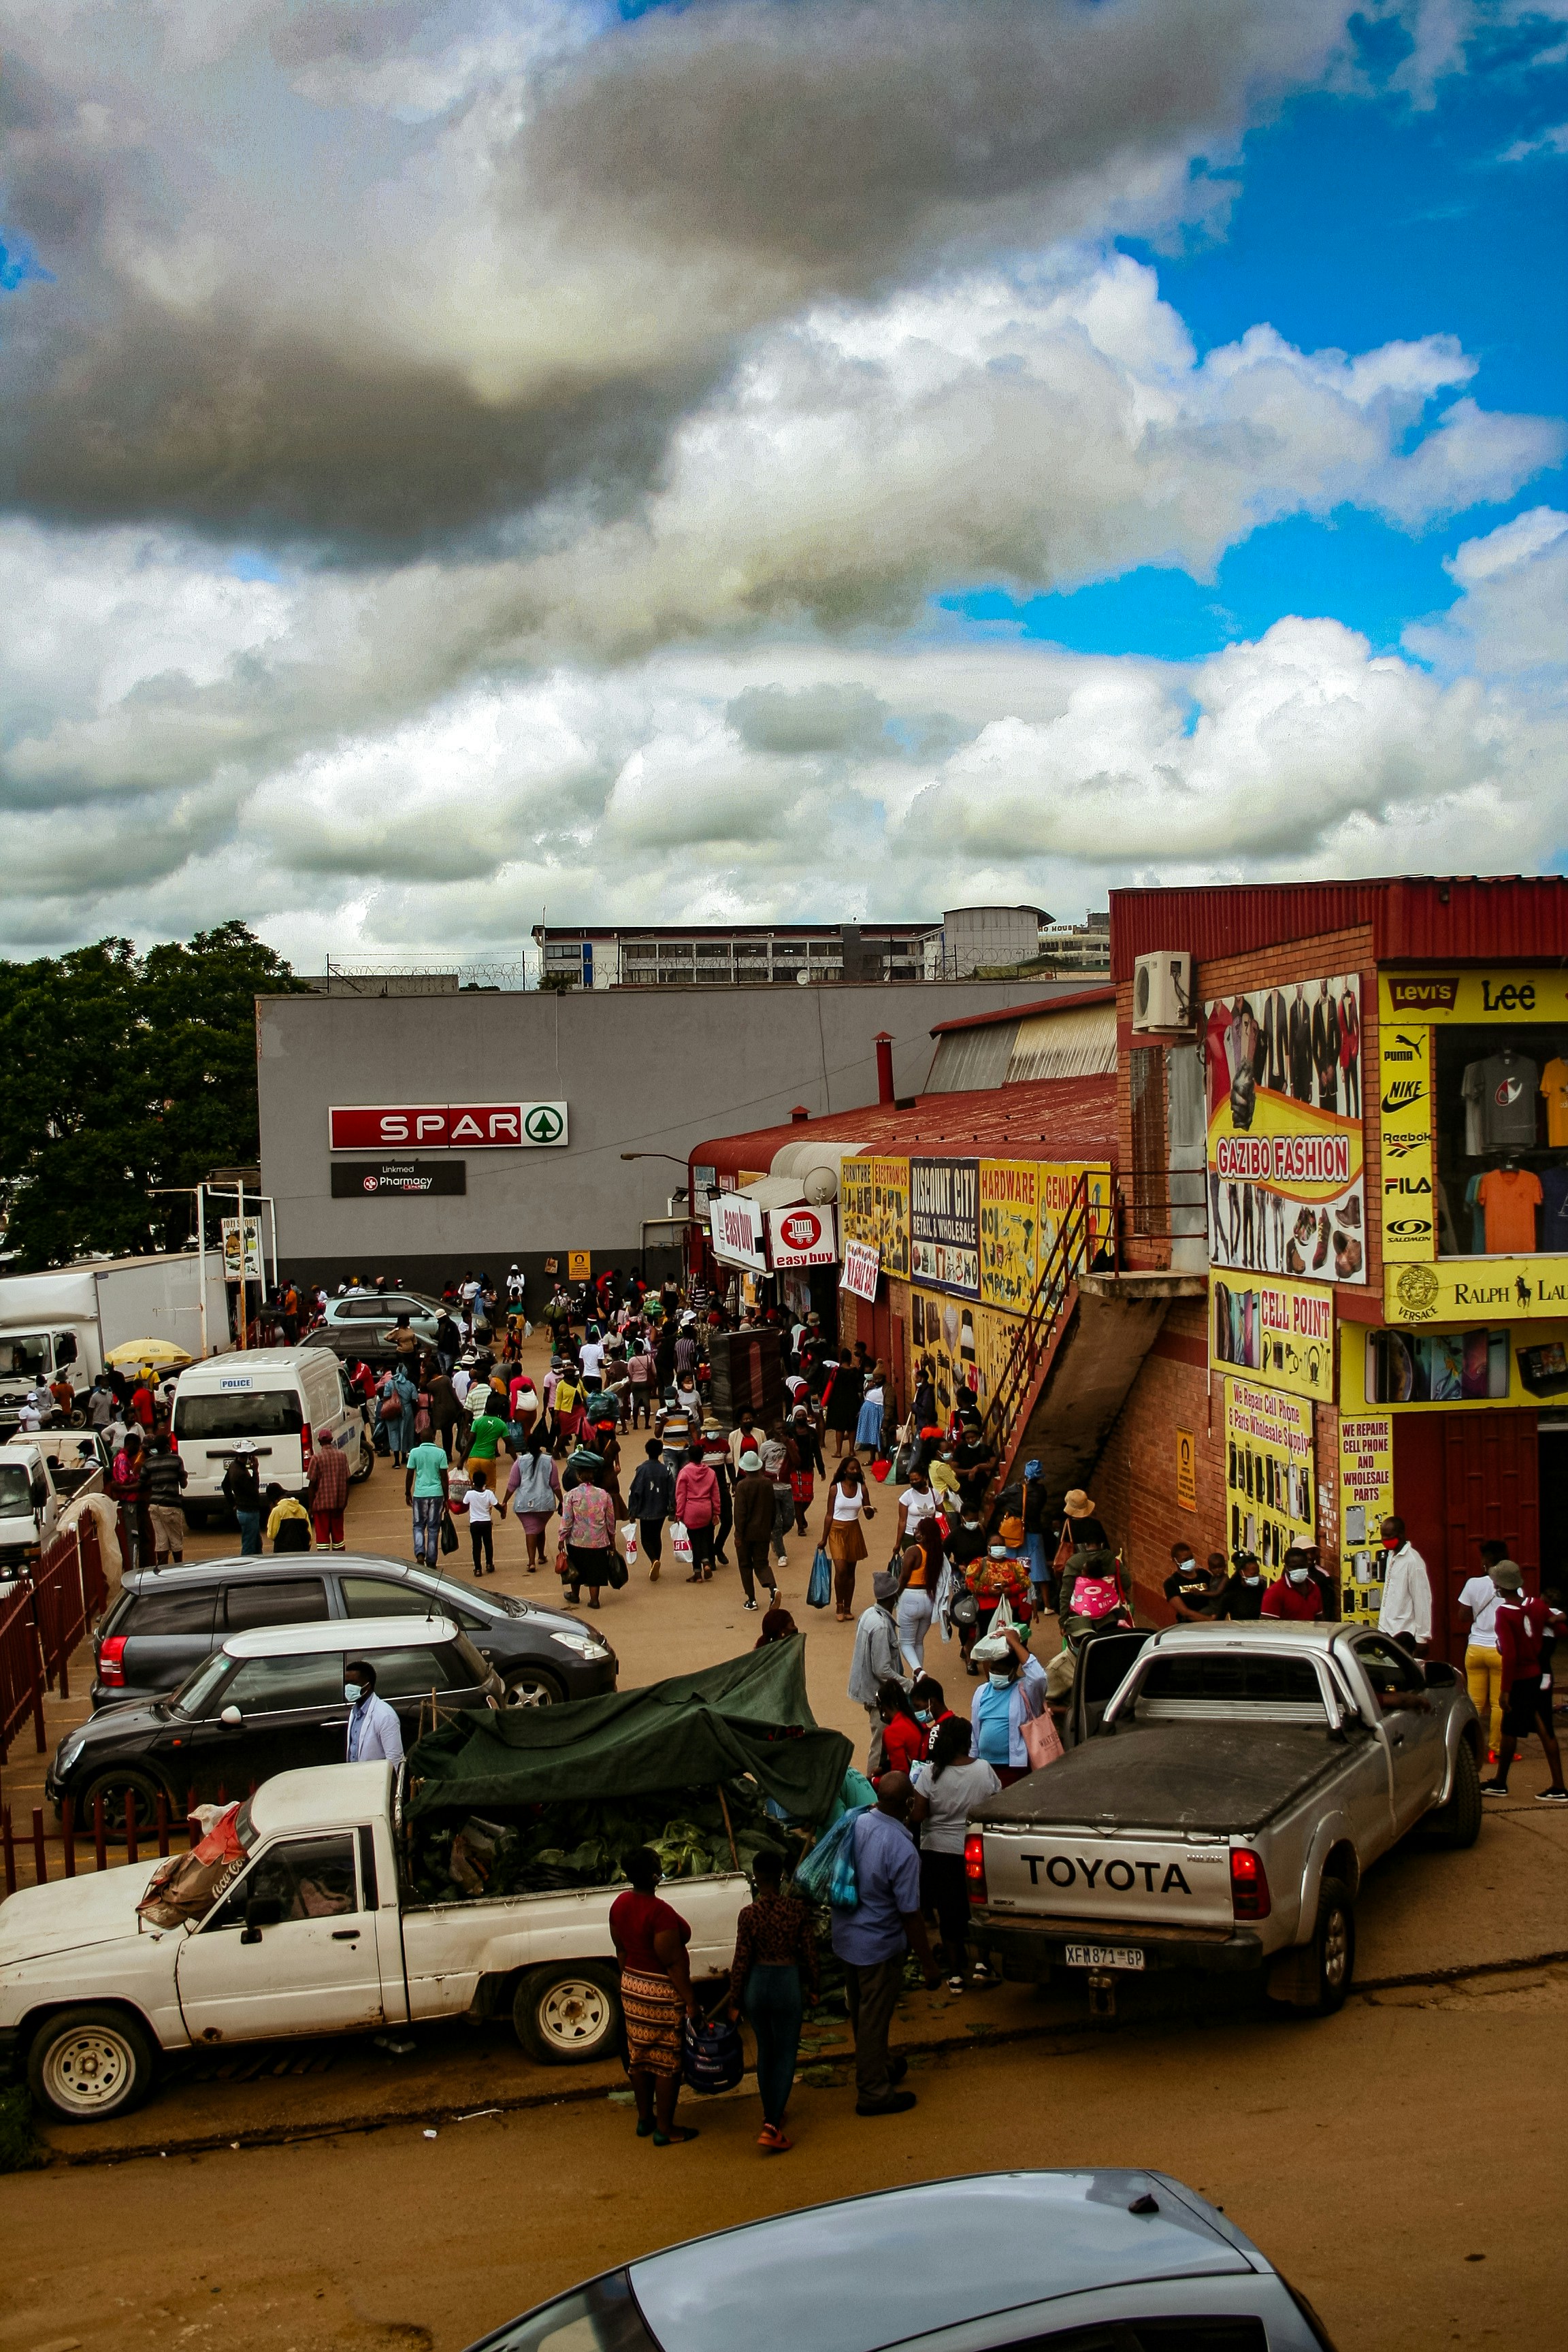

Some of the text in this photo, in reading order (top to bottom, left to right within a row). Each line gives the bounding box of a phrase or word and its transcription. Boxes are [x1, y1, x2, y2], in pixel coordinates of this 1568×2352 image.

[1481, 980, 1535, 1011] Lee
[1384, 1051, 1413, 1061] PUMA
[1389, 1081, 1422, 1098] NIKE
[380, 1113, 519, 1141] SPAR
[1383, 1132, 1431, 1143] Reebok
[1218, 1139, 1348, 1179] GAZIBO FASHION
[843, 1164, 871, 1183] FURNITURE
[380, 1177, 433, 1189] Pharmacy
[982, 1169, 1034, 1205] HARDWARE
[1385, 1177, 1432, 1194] FILA
[912, 1167, 976, 1219] DISCOUNT CITY
[724, 1205, 754, 1256] easy buy
[913, 1215, 932, 1237] RETAIL
[938, 1218, 976, 1244] WHOLESALE
[777, 1252, 833, 1266] easy buy
[1454, 1284, 1509, 1304] RALPH
[1261, 1290, 1330, 1339] CELL POINT
[1398, 1305, 1439, 1321] VERSACE
[222, 1379, 250, 1388] POLICE
[1233, 1384, 1300, 1423] We Repair Cell Phone
[1234, 1409, 1249, 1432] Parts
[1250, 1415, 1282, 1444] Wholesale
[1284, 1426, 1309, 1457] Supply
[1342, 1422, 1389, 1437] WE REPAIRE
[1343, 1438, 1388, 1453] CELL PHONE
[1358, 1455, 1374, 1469] AND
[1343, 1471, 1389, 1486] WHOLESALE
[1354, 1487, 1379, 1501] PARTS
[1020, 1855, 1192, 1895] TOYOTA
[1127, 1949, 1142, 1965] GP
